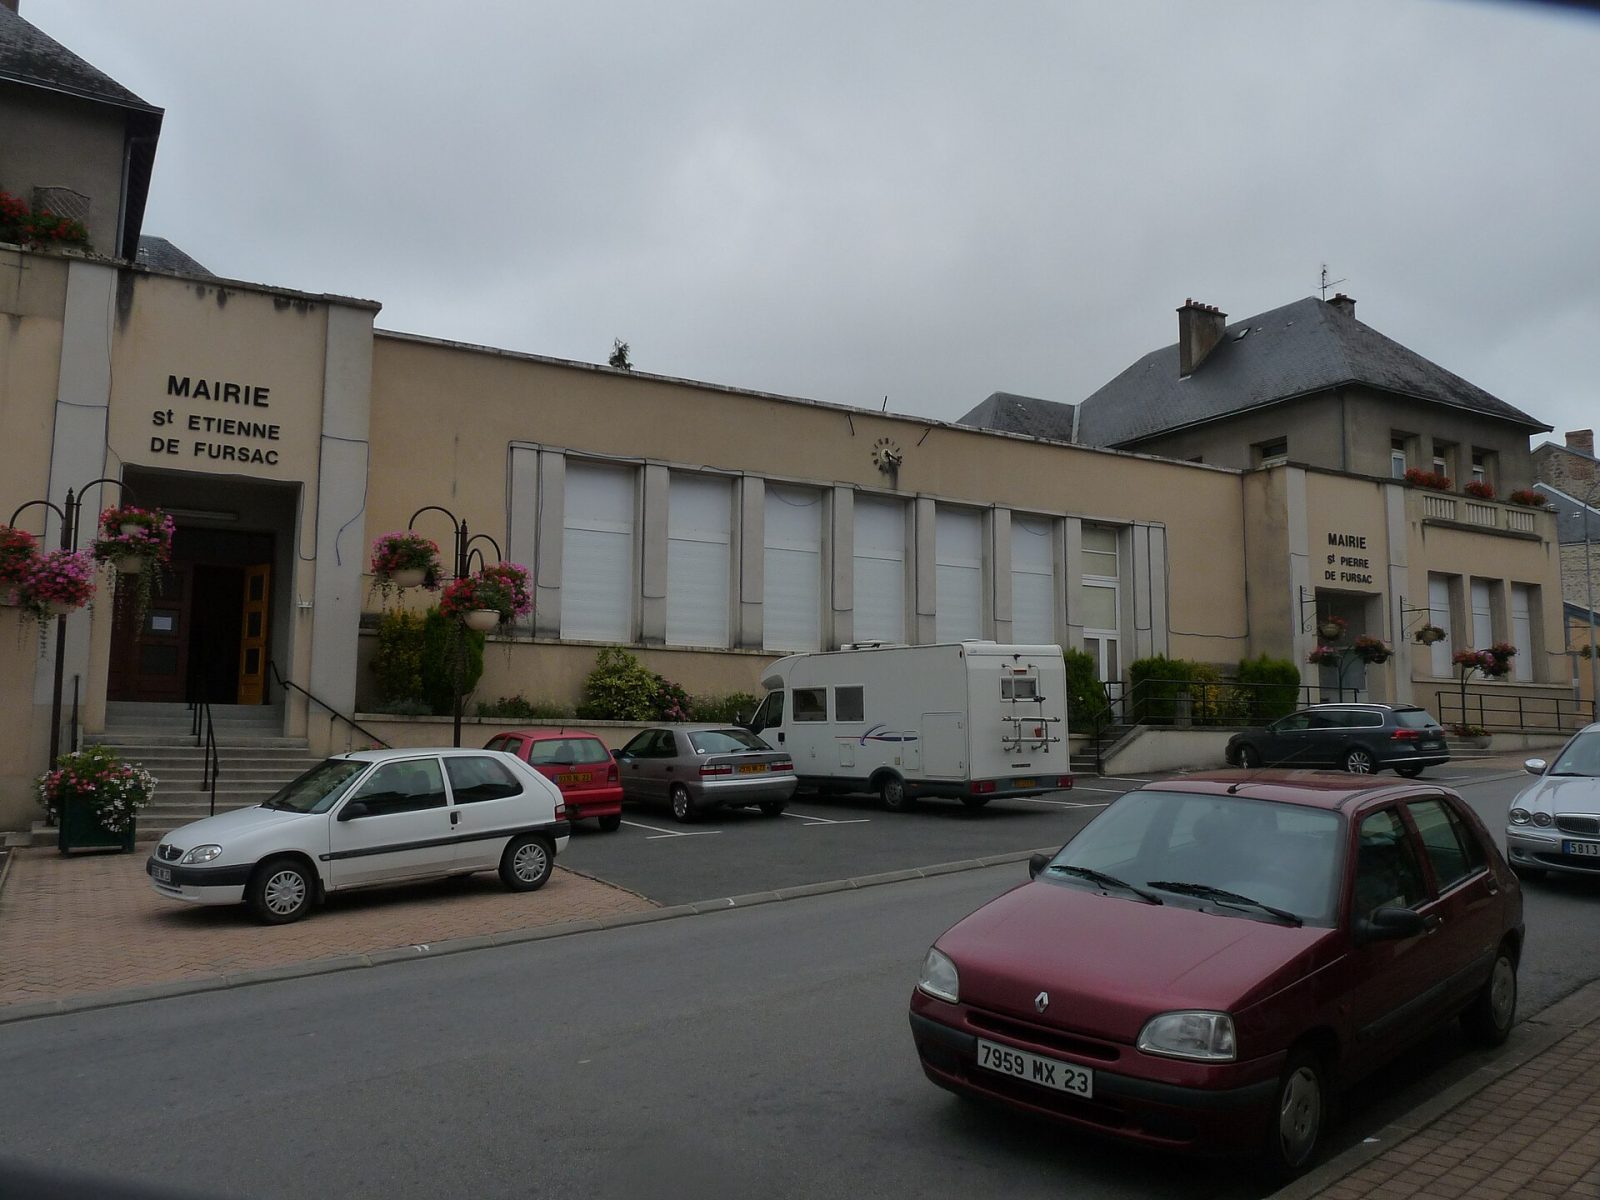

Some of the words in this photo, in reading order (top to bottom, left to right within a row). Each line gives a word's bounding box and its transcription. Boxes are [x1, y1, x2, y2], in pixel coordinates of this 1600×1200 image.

[167, 375, 270, 408] MAIRIE
[152, 409, 174, 426] St
[188, 414, 280, 441] ETIENNE
[150, 437, 180, 455] DE
[194, 441, 279, 466] FURSAC
[1328, 533, 1367, 550] MAIRIE
[1340, 556, 1370, 569] PIERRE
[1325, 570, 1336, 581] DE
[1340, 572, 1373, 584] FURSAC
[1571, 843, 1598, 855] 5813
[981, 1044, 1024, 1075] 7959
[1032, 1060, 1056, 1085] MX
[1064, 1069, 1088, 1093] 23
